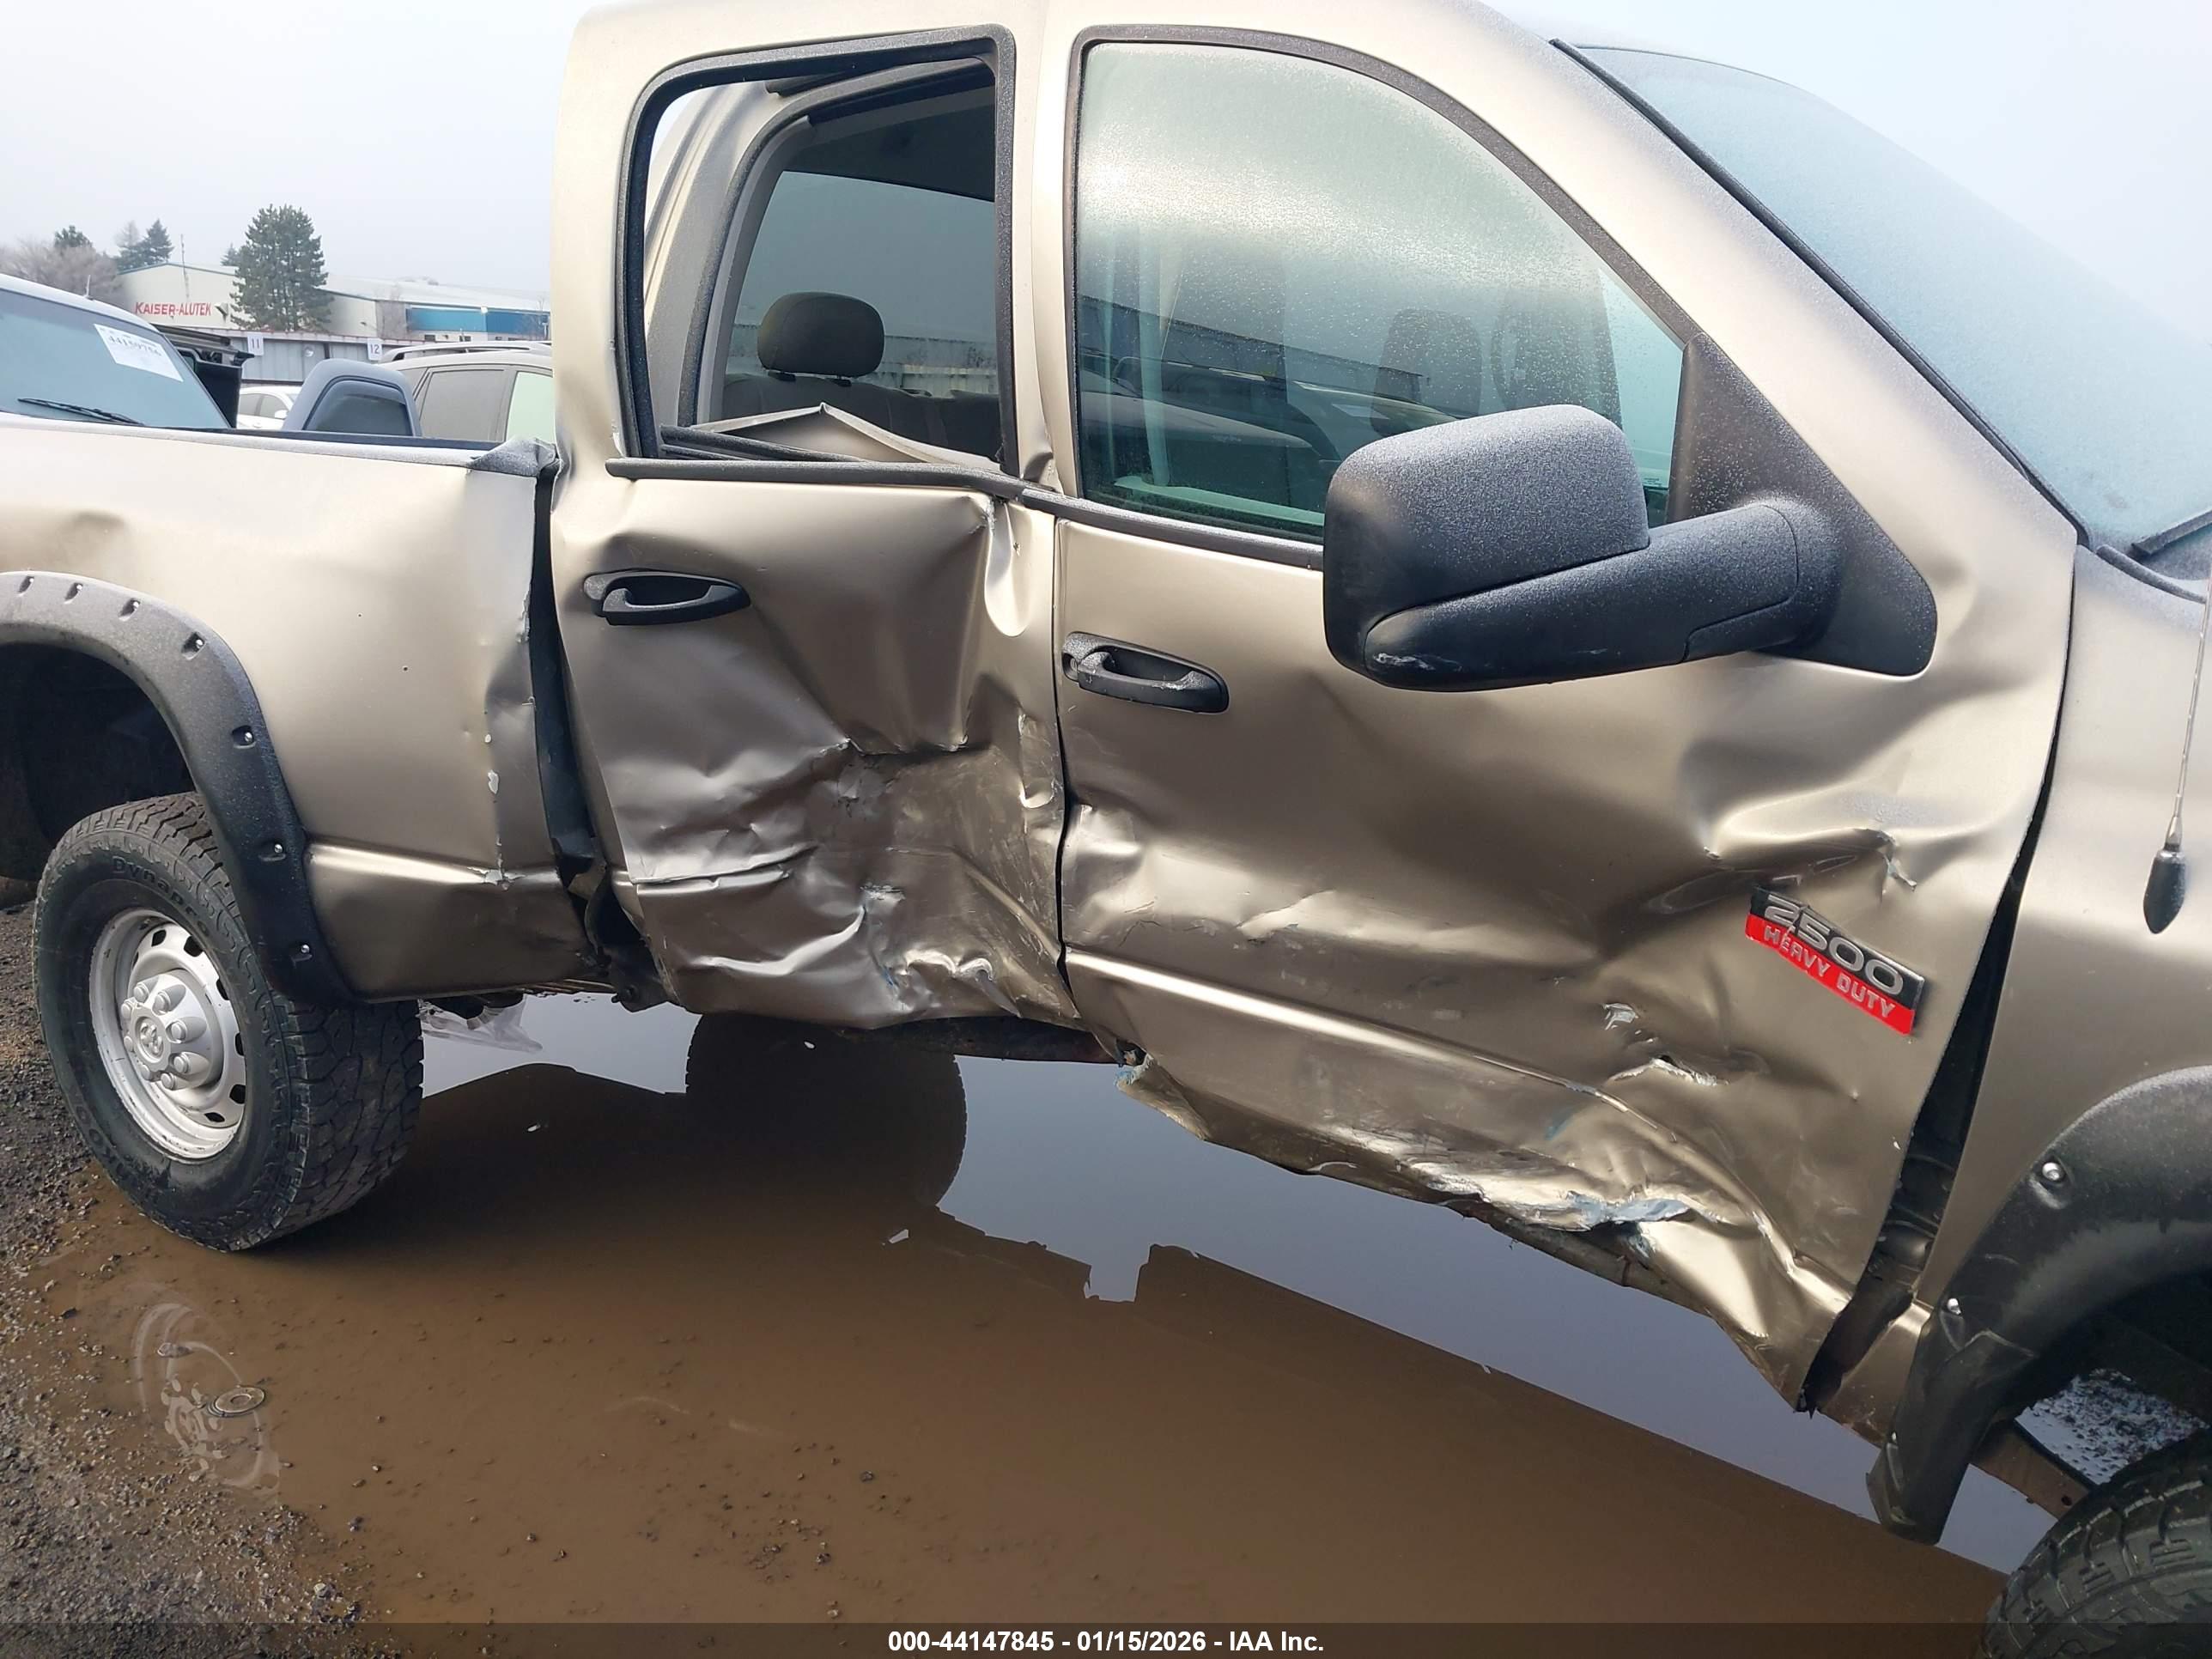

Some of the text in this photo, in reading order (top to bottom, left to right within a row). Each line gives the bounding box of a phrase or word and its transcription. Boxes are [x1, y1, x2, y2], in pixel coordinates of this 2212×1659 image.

[135, 301, 212, 317] KAISER-ALUTEK
[251, 337, 260, 349] 11
[370, 343, 380, 355] 12
[112, 854, 211, 938] Dynapro
[1764, 893, 1905, 996] 2500
[1763, 924, 1896, 1018] HEAVY DUTY
